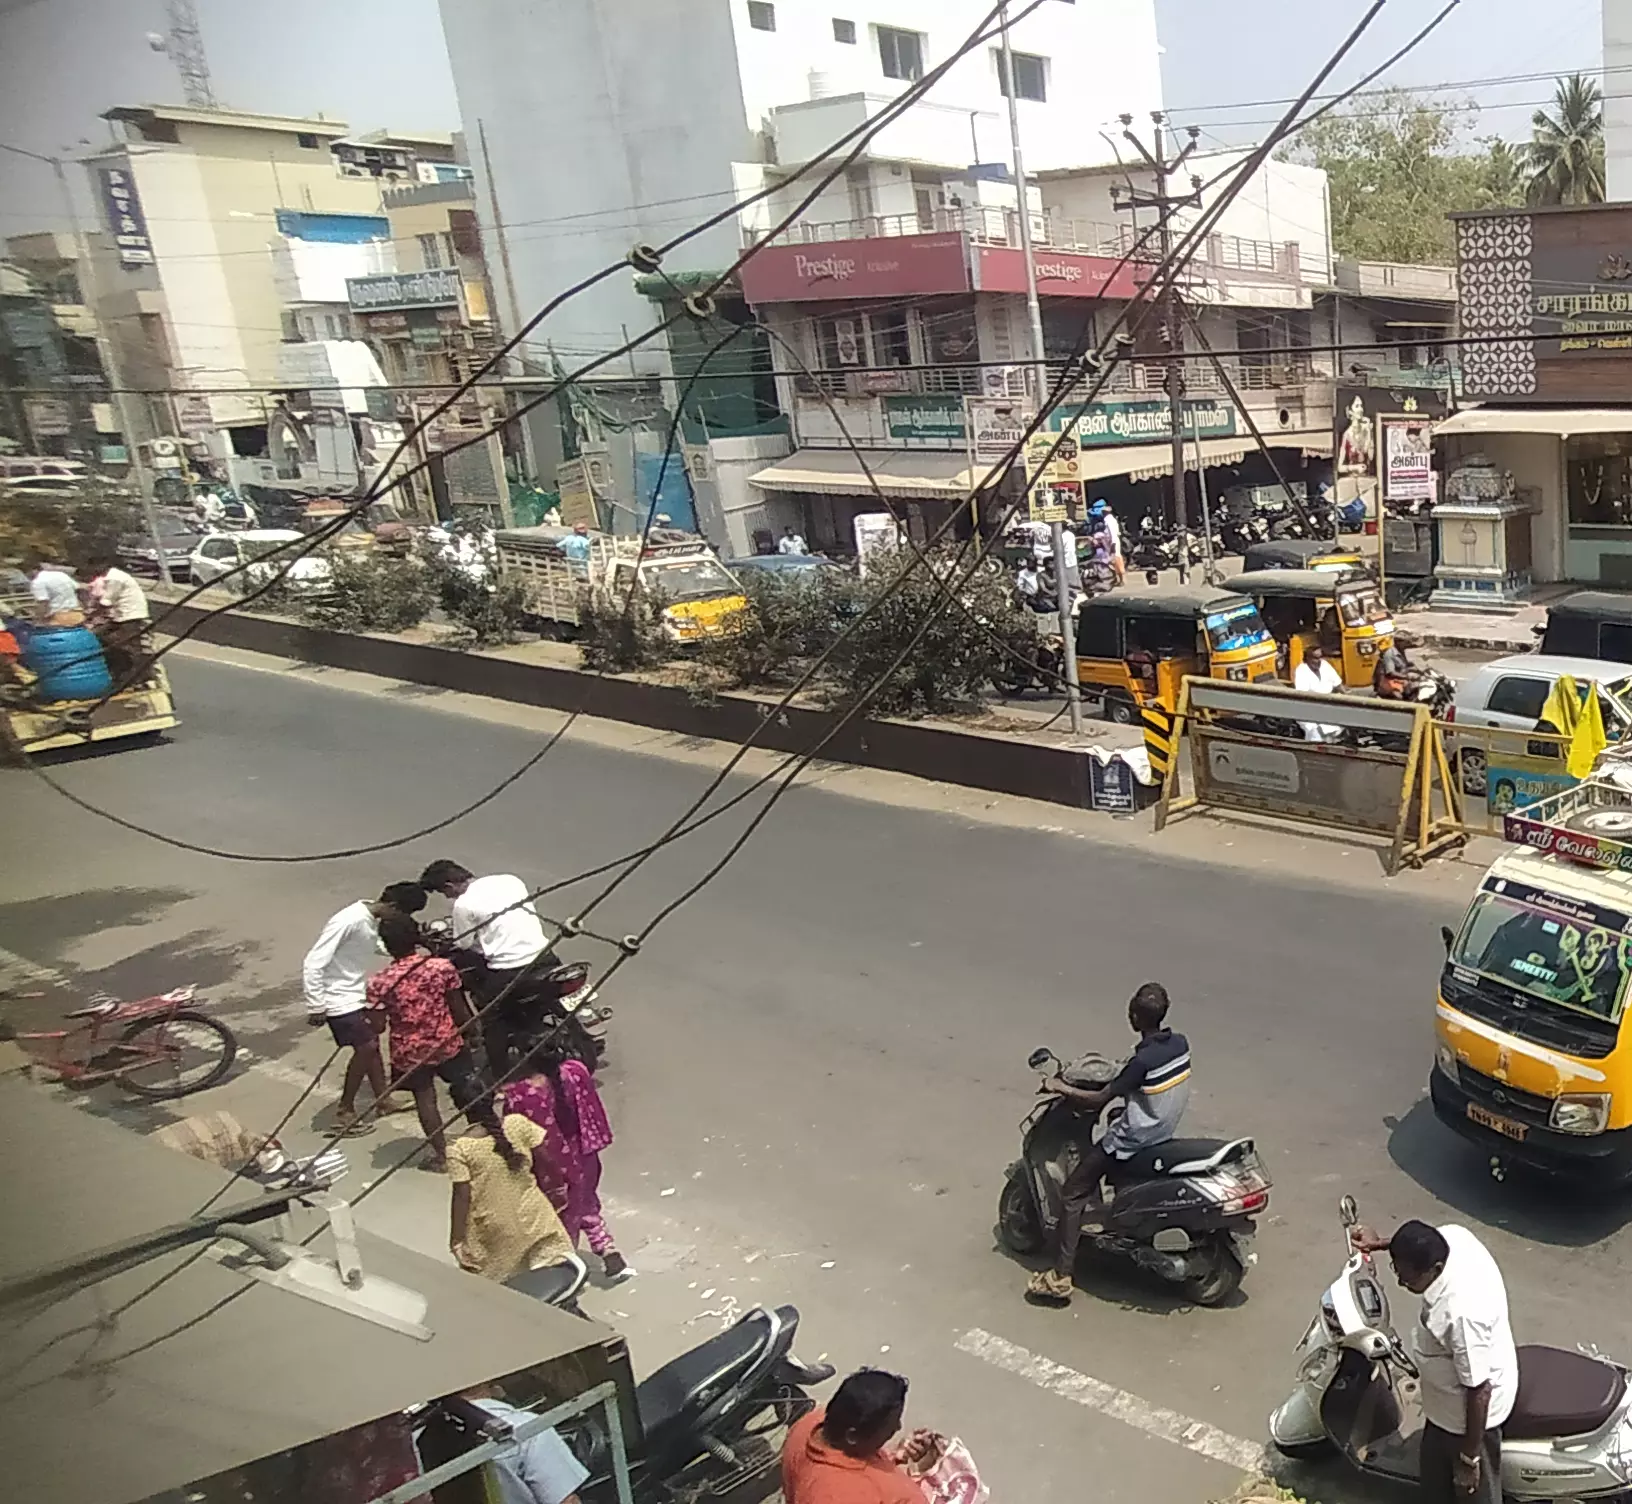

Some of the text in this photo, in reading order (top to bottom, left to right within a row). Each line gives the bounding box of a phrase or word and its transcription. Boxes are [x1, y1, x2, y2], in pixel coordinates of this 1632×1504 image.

[795, 253, 856, 280] Prestige
[1035, 260, 1082, 281] restige
[1390, 452, 1428, 469] அன்பு
